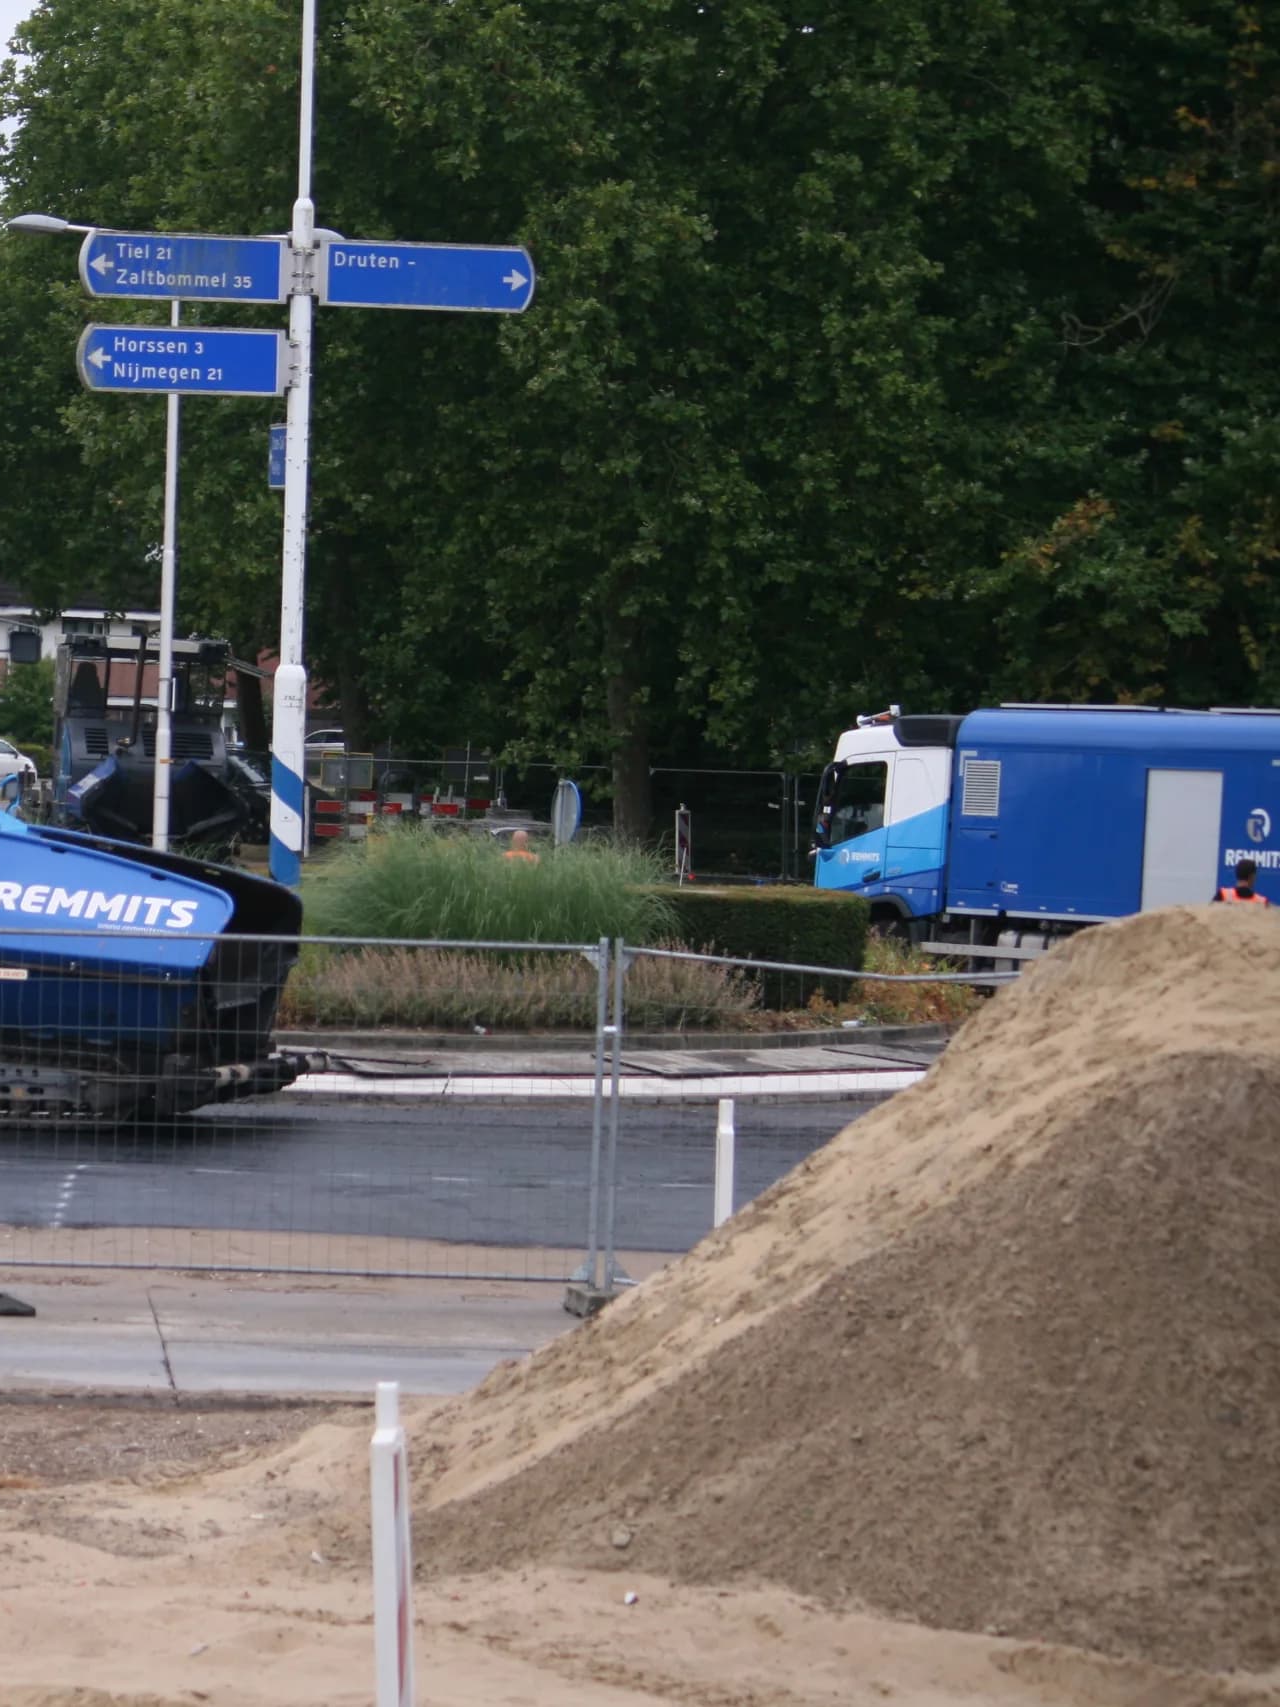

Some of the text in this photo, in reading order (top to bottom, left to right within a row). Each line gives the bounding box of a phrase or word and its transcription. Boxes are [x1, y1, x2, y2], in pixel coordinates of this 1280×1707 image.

[116, 243, 171, 260] Tiel 21
[334, 251, 400, 268] Druten
[116, 269, 253, 289] Zaltbommel 35
[113, 336, 204, 355] Horssen 3
[113, 363, 223, 384] Nijmegen 21
